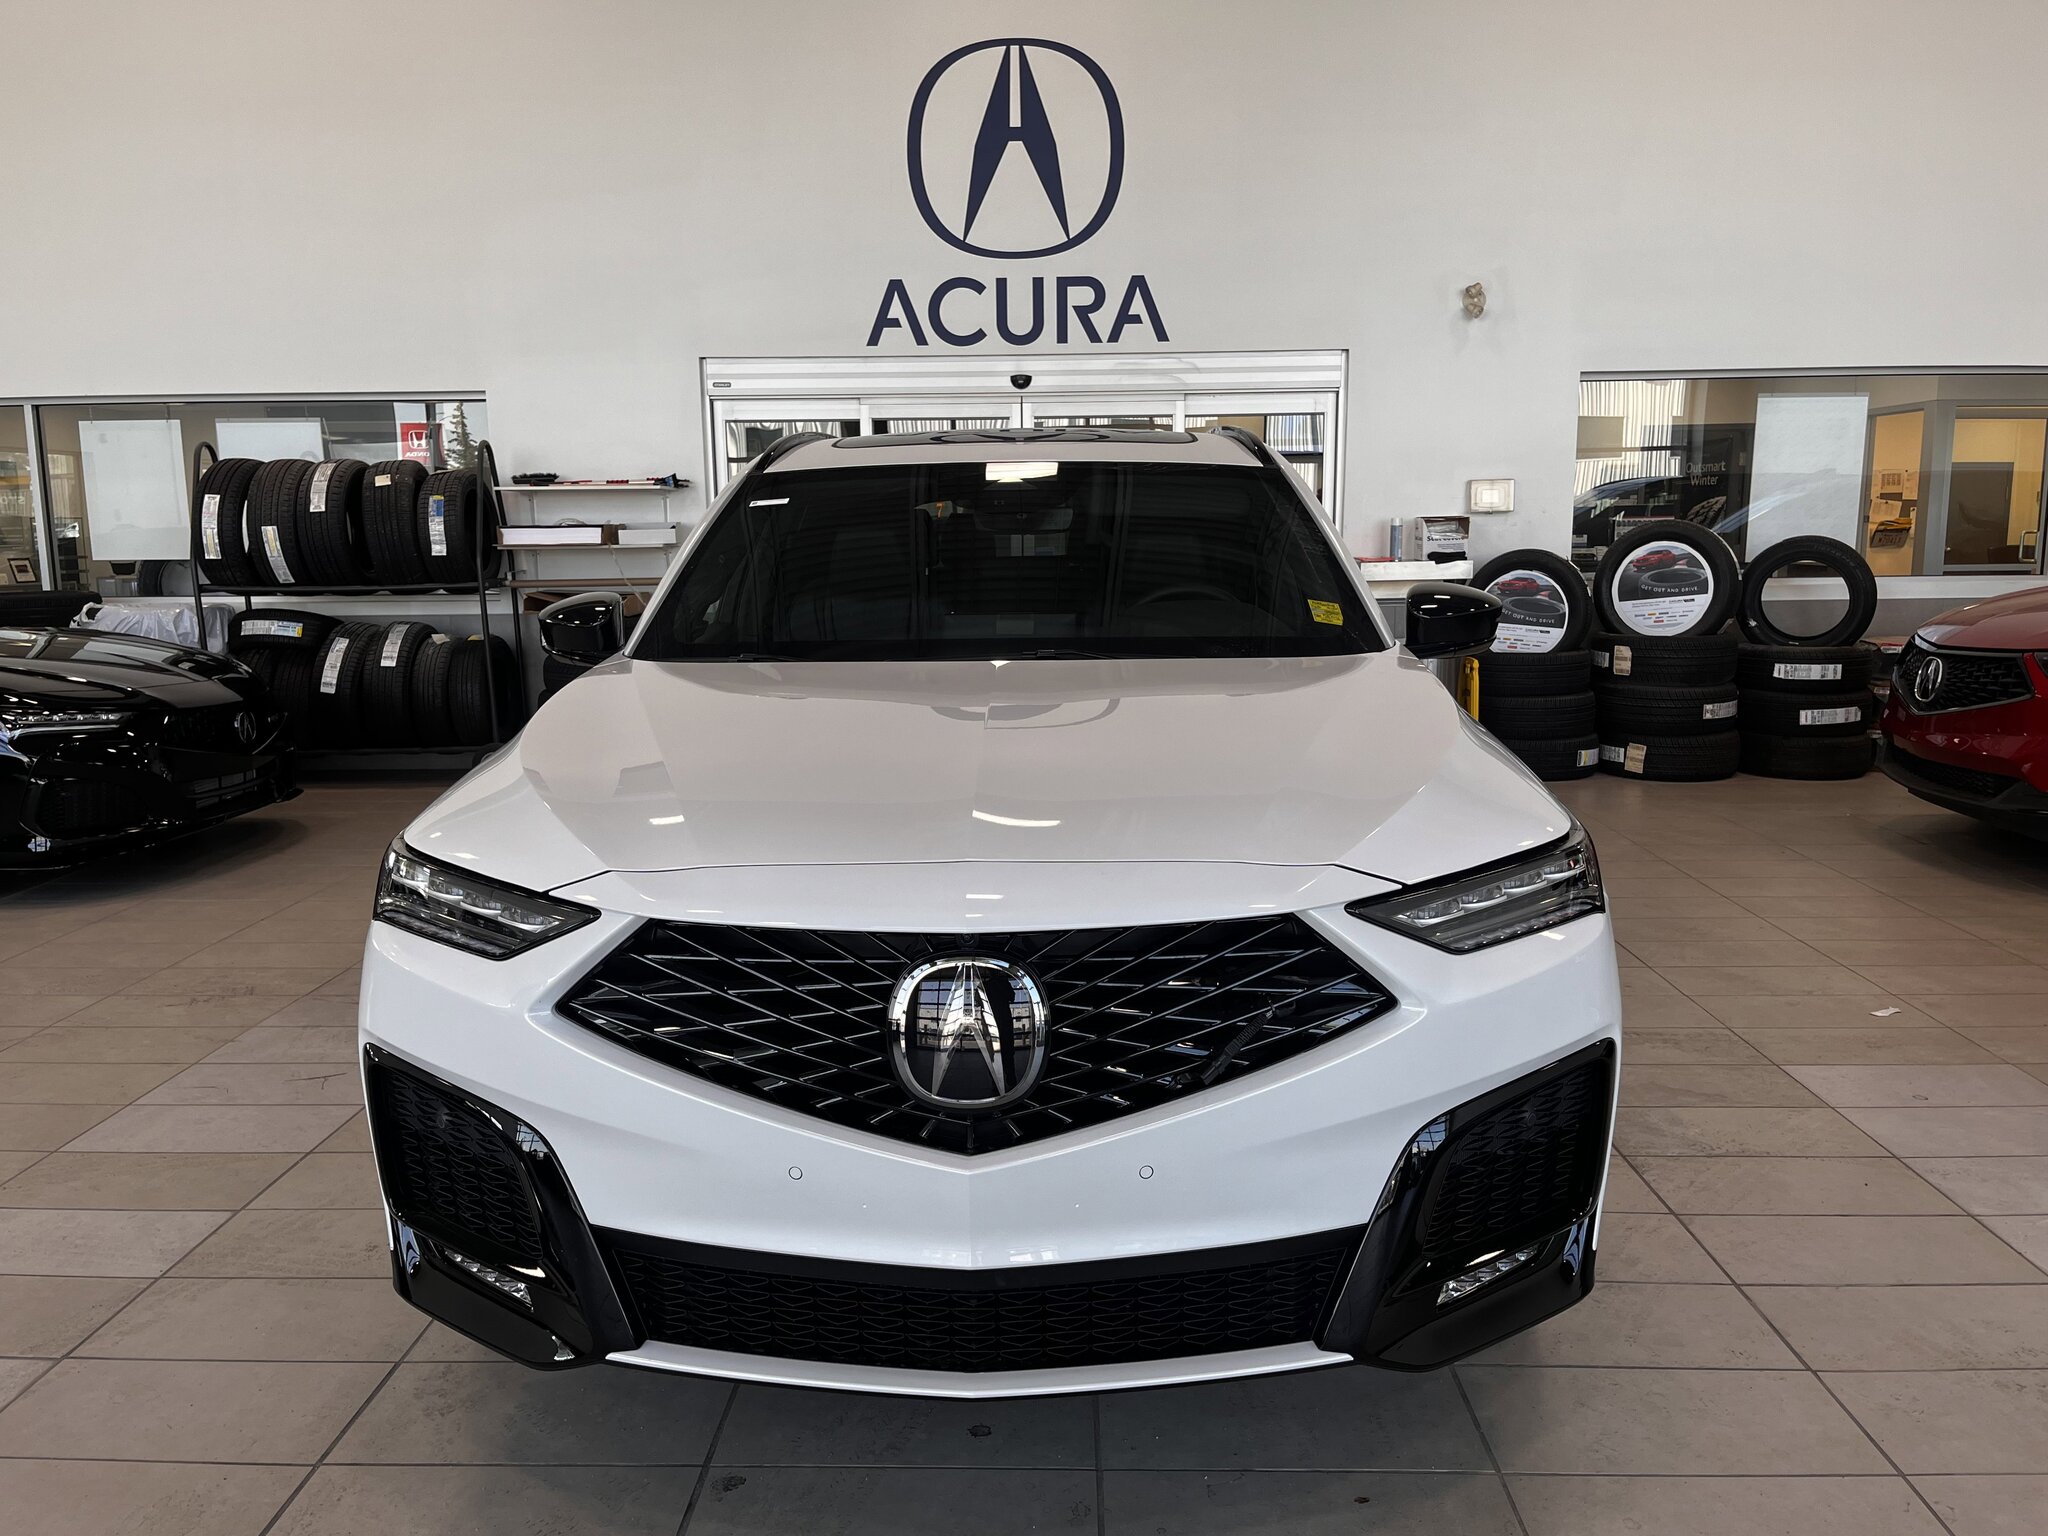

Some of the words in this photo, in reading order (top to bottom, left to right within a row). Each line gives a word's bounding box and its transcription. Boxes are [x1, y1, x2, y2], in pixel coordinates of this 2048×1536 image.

[866, 274, 1170, 347] ACURA
[1686, 460, 1727, 473] Outsmart
[1690, 473, 1719, 486] Winter
[1681, 585, 1698, 593] DRIVE
